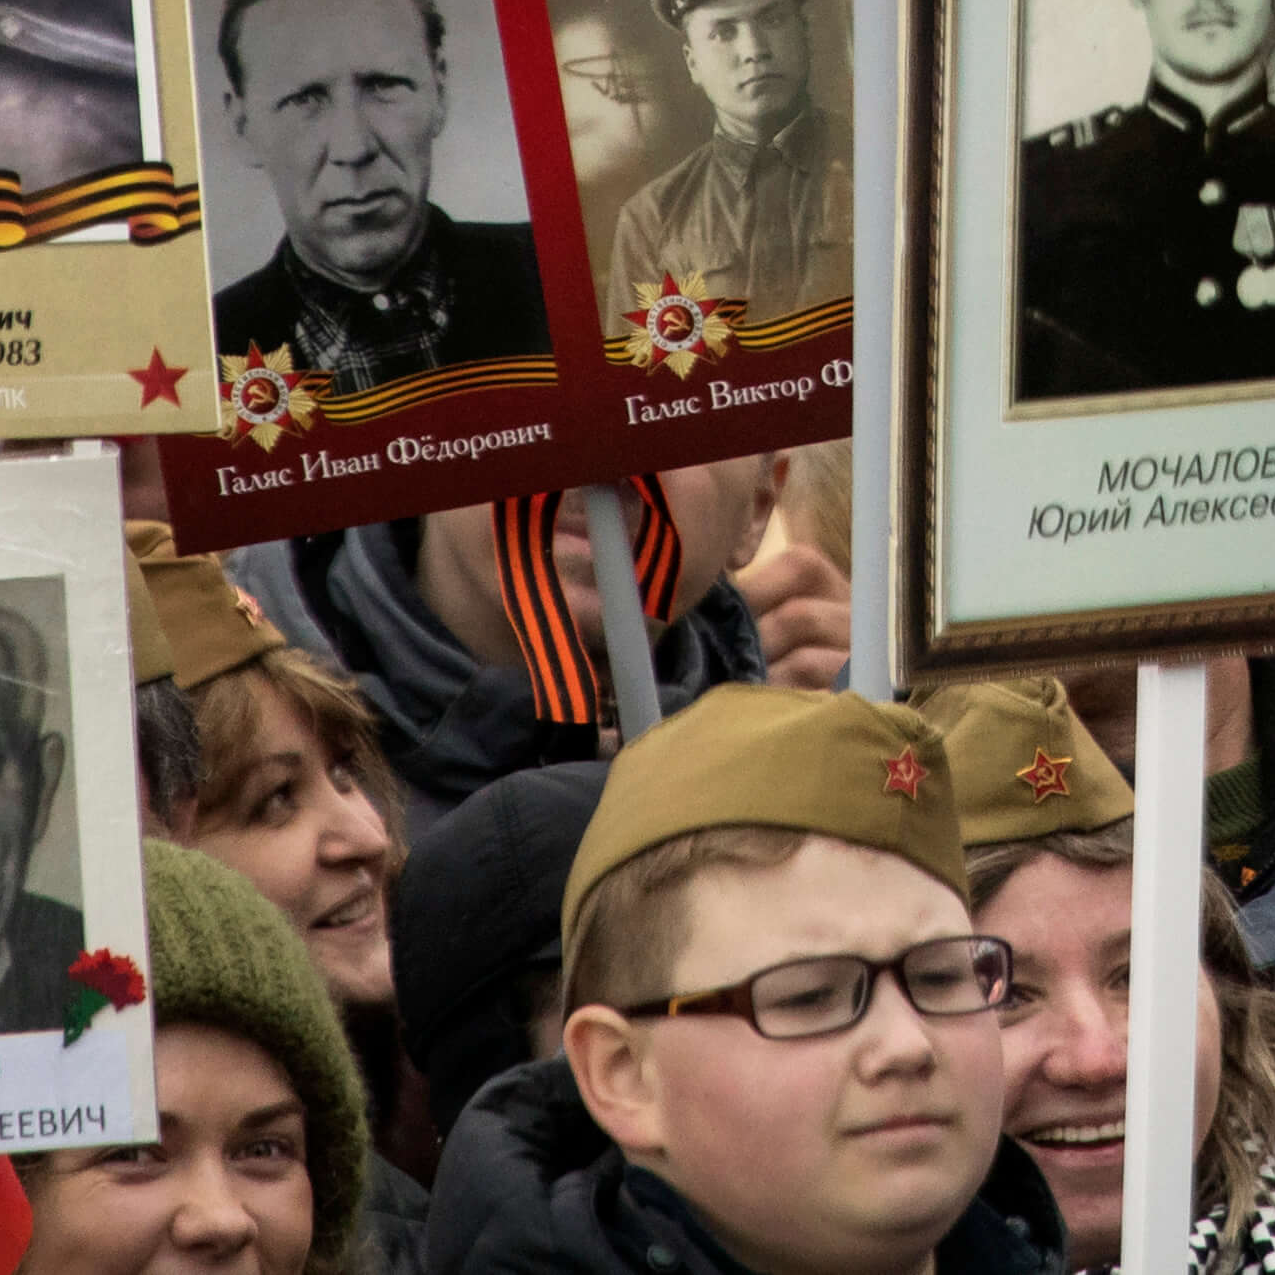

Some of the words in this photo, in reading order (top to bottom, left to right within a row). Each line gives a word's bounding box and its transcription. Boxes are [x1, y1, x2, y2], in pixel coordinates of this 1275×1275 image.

[625, 388, 701, 426] Галяс
[707, 374, 814, 415] Виктор
[216, 457, 294, 496] Галяс
[301, 448, 381, 484] Иван
[386, 421, 552, 468] Фёдорович
[1027, 498, 1132, 544] Юрий
